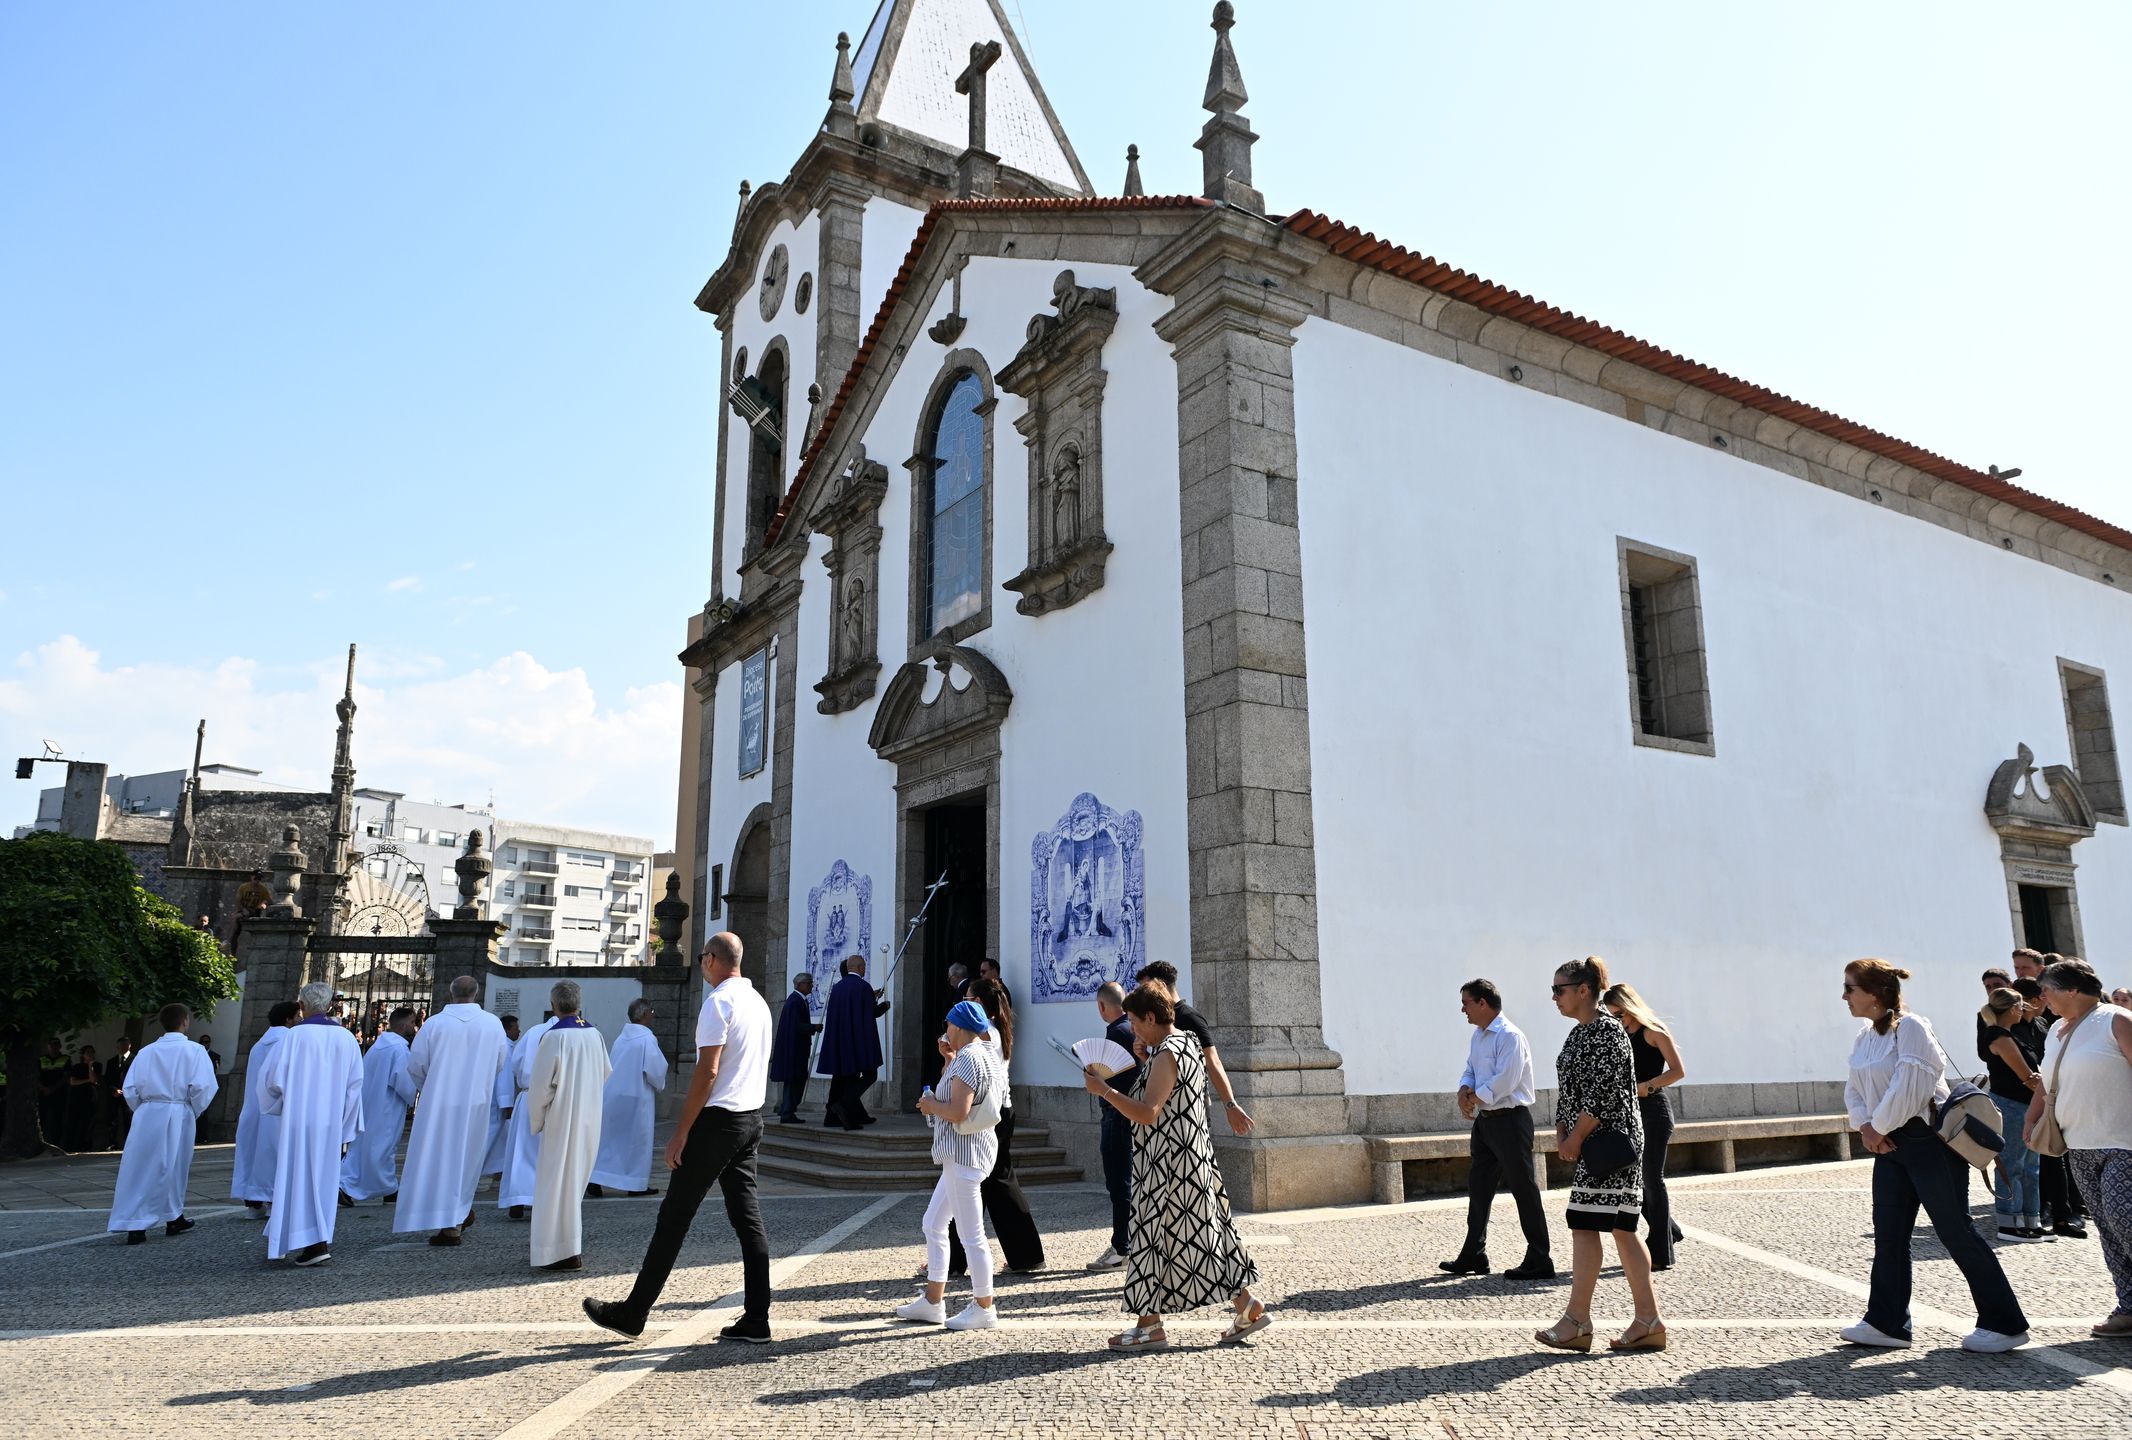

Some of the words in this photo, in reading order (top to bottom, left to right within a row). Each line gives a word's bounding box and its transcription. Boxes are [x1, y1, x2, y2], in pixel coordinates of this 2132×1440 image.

[745, 661, 763, 677] Diocese
[744, 676, 763, 699] Porto
[377, 844, 398, 853] 1862
